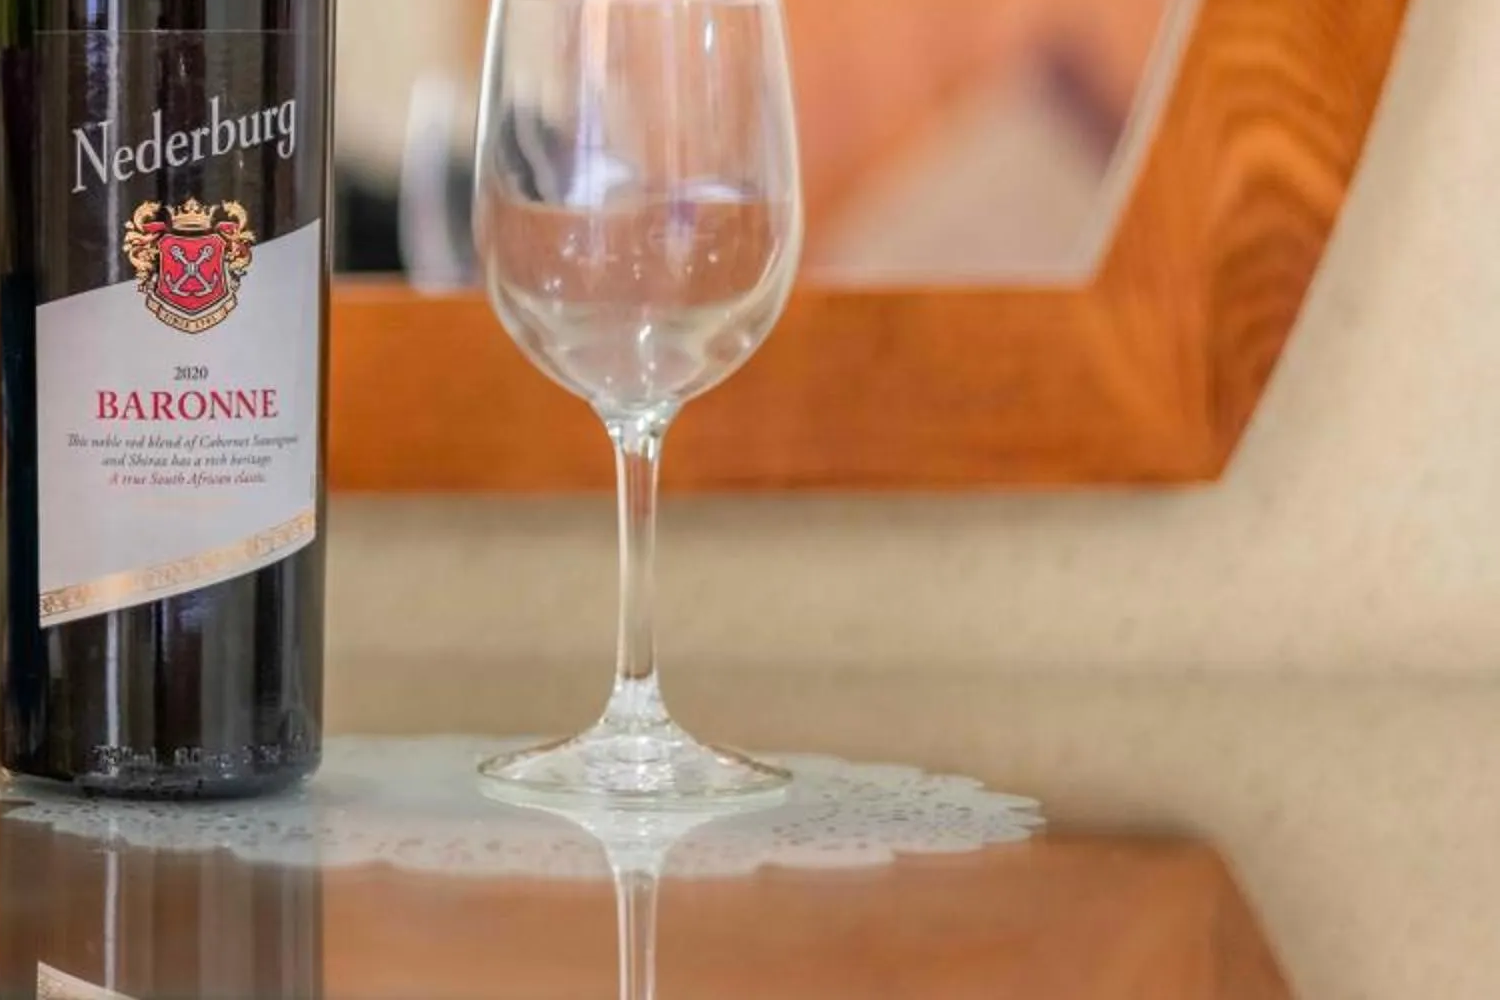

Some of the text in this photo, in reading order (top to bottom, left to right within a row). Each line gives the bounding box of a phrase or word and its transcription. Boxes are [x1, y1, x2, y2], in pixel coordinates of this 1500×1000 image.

[71, 95, 296, 193] Nederburg
[173, 366, 208, 381] 2020
[96, 389, 278, 421] BARONNE
[66, 432, 87, 447] This
[91, 431, 122, 448] noble
[125, 433, 145, 449] red
[147, 433, 182, 449] blend
[184, 434, 199, 452] of
[199, 432, 250, 448] Cabernet
[101, 453, 125, 467] and
[128, 453, 168, 467] Shiraz
[171, 453, 191, 467] has
[194, 458, 201, 467] a
[204, 453, 227, 466] rich
[109, 471, 119, 485] A
[122, 473, 147, 485] true
[149, 471, 185, 486] South
[187, 471, 232, 488] African
